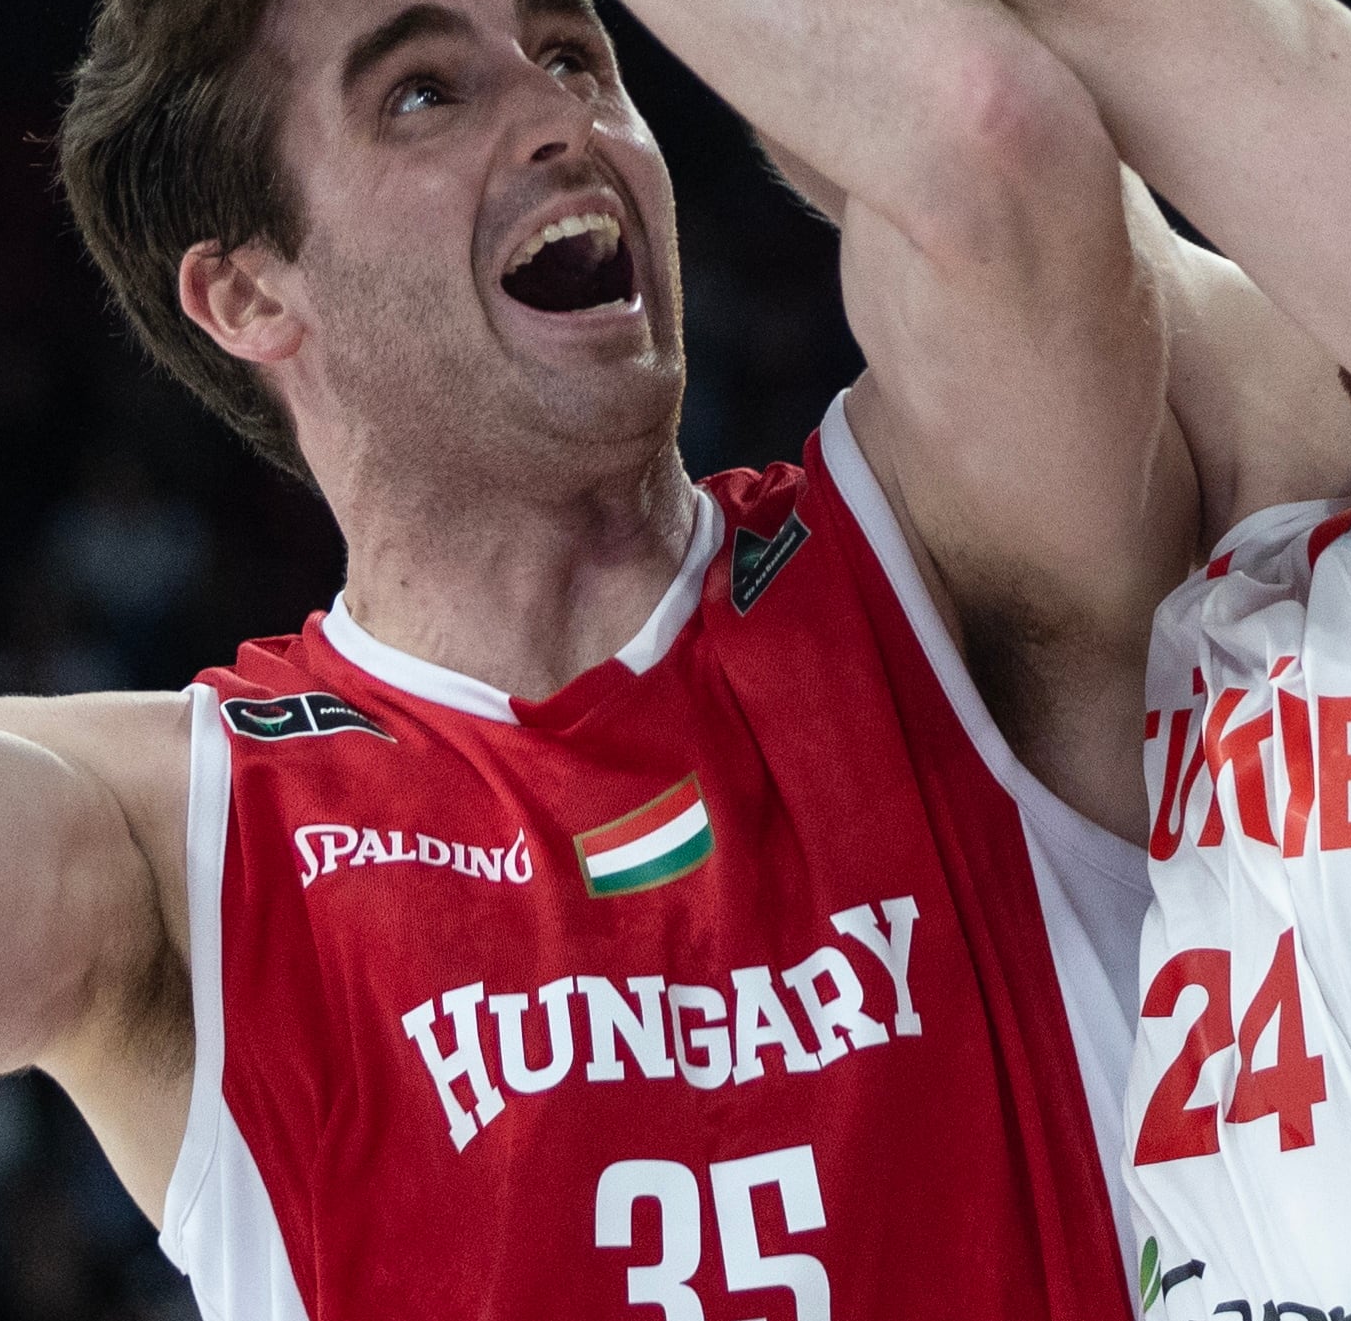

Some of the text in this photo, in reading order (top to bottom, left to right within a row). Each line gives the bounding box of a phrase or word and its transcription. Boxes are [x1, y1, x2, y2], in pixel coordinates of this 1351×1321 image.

[293, 823, 534, 889] SPALDING
[401, 894, 923, 1154] HUNGARY
[1133, 925, 1328, 1168] 24
[594, 1143, 832, 1321] 35
